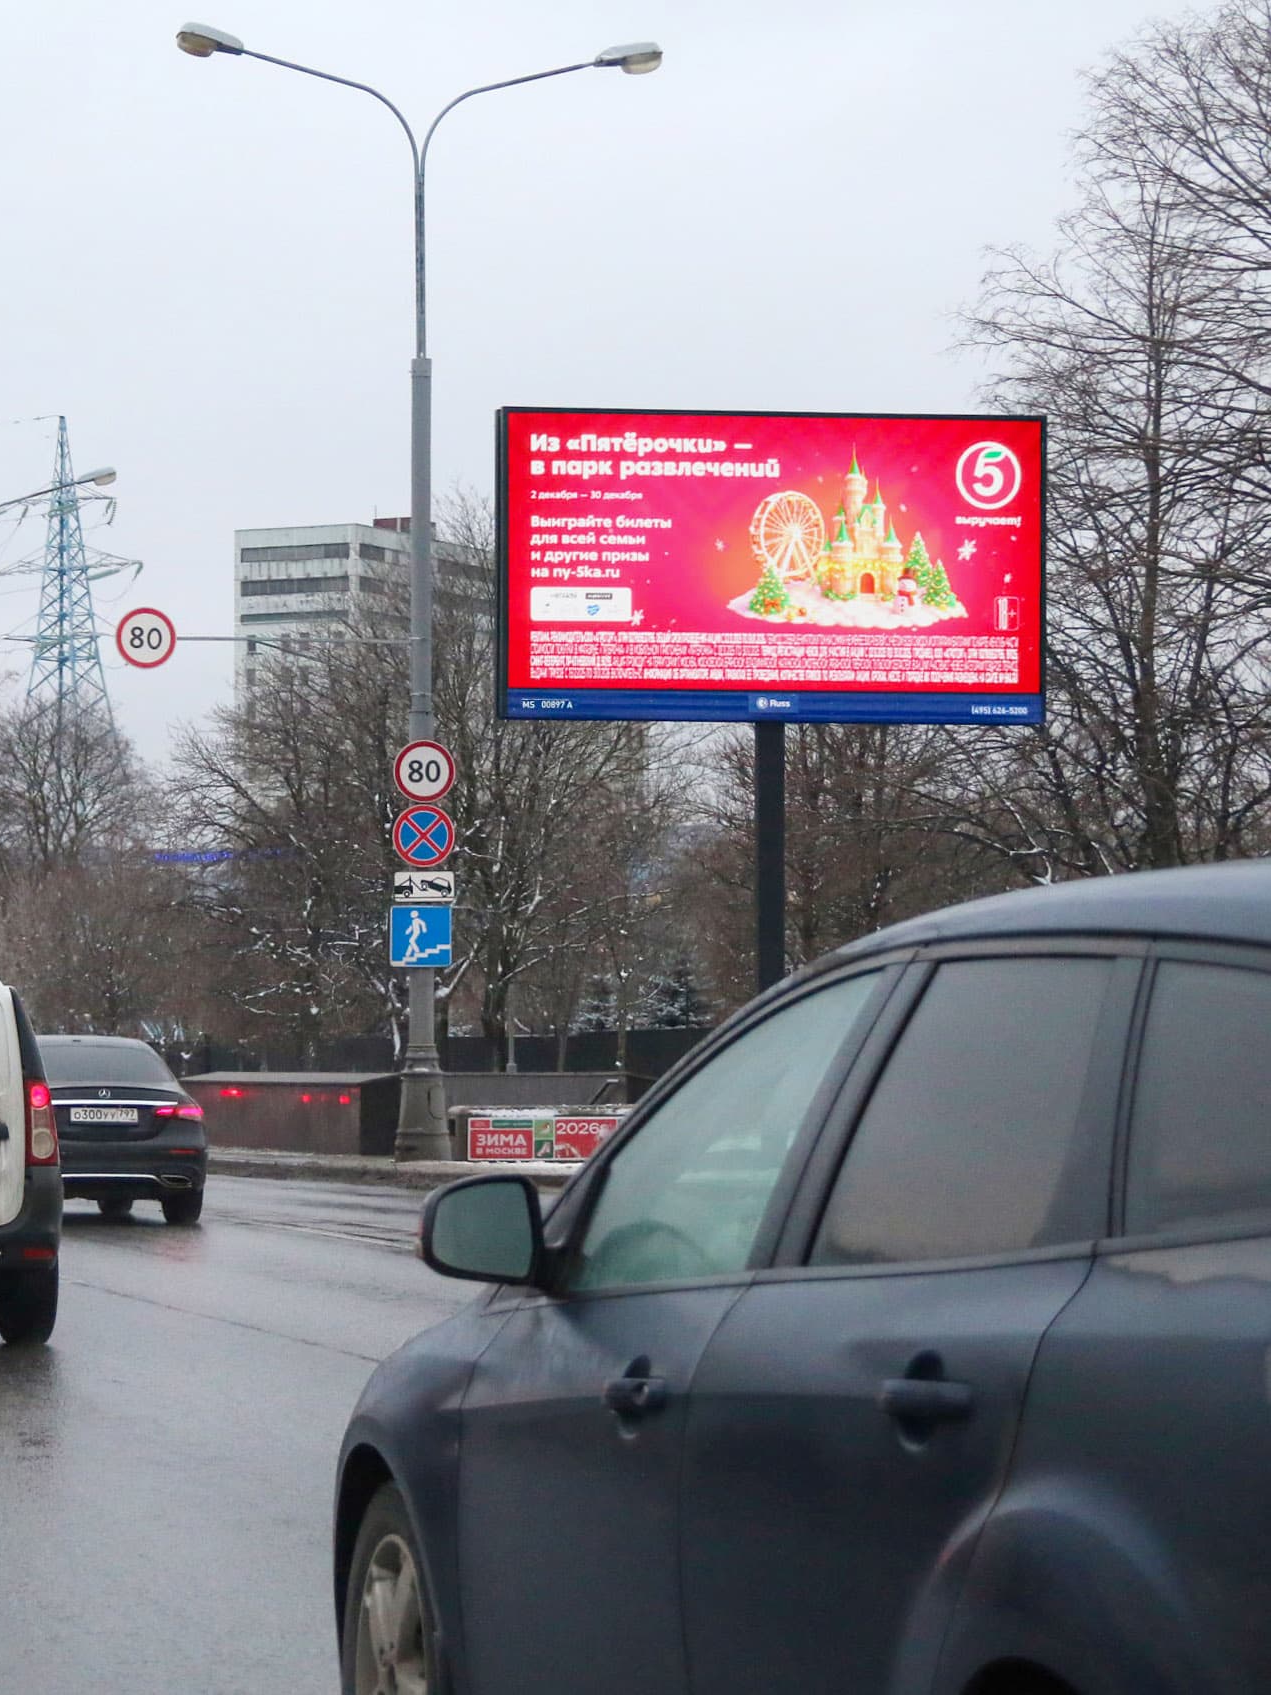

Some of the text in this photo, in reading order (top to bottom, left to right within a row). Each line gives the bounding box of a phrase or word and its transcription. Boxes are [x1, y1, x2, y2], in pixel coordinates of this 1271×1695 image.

[529, 433, 561, 452] Из
[566, 432, 727, 457] «Пятёрочки»
[530, 458, 781, 480] в парк развлечений
[530, 490, 537, 499] 2
[538, 490, 578, 501] декабря
[590, 490, 602, 500] 30
[603, 490, 643, 501] декабря
[530, 515, 672, 531] Выиграйте билеты
[530, 532, 646, 546] для всей семьи
[530, 550, 649, 564] и другие призы
[530, 565, 621, 580] на ny-5ka.ru
[129, 626, 162, 650] 80
[522, 700, 535, 709] MS
[408, 759, 441, 783] 80
[476, 1133, 527, 1146] ЗИМА
[476, 1147, 528, 1155] В МОСКВЕ
